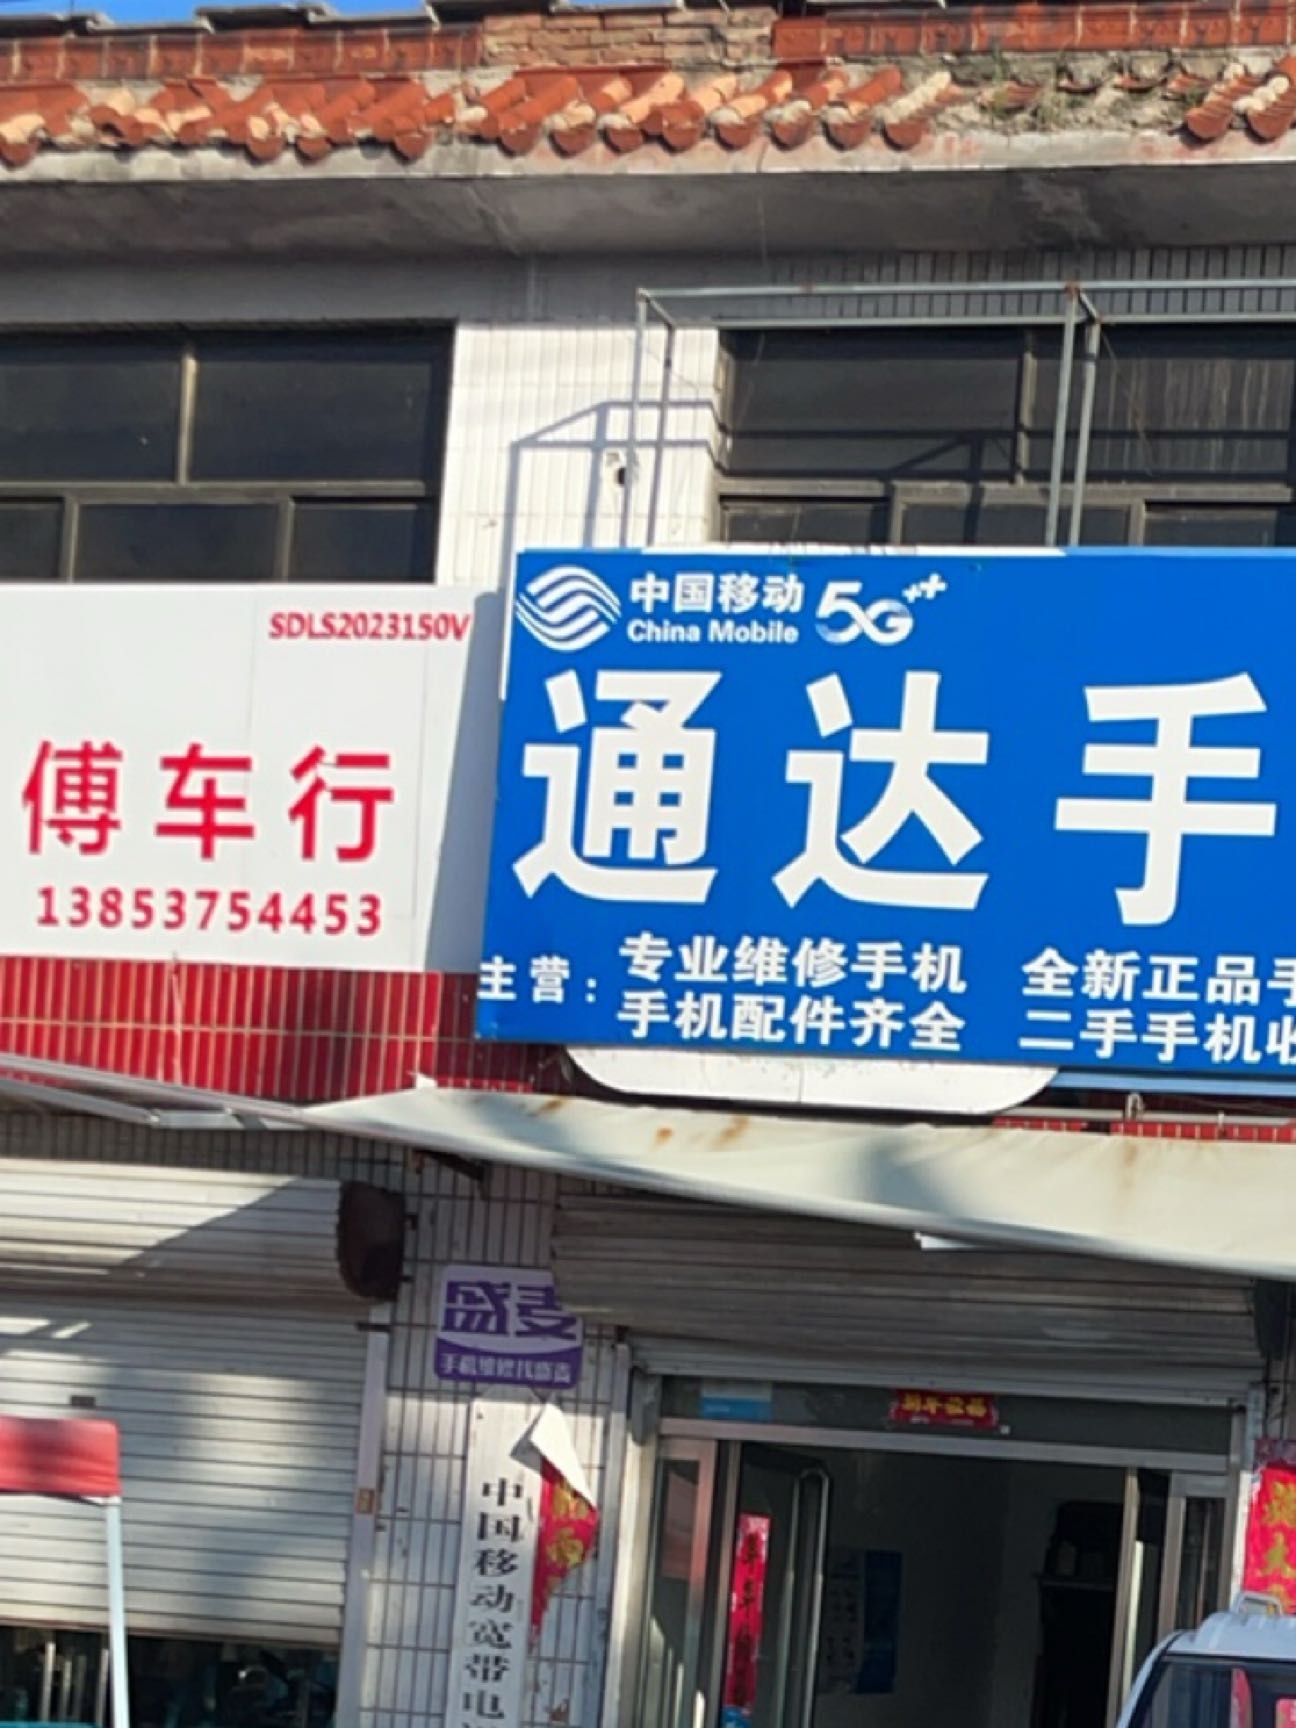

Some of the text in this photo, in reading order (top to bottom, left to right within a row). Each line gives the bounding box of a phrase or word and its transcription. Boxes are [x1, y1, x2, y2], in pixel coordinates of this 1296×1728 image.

[628, 571, 805, 614] 中国移动
[626, 618, 799, 645] China Mobile
[22, 740, 396, 862] 傅车行
[36, 886, 382, 935] 13853754453
[618, 930, 967, 994] 专业维修手机
[616, 989, 967, 1051] 手机配件齐全
